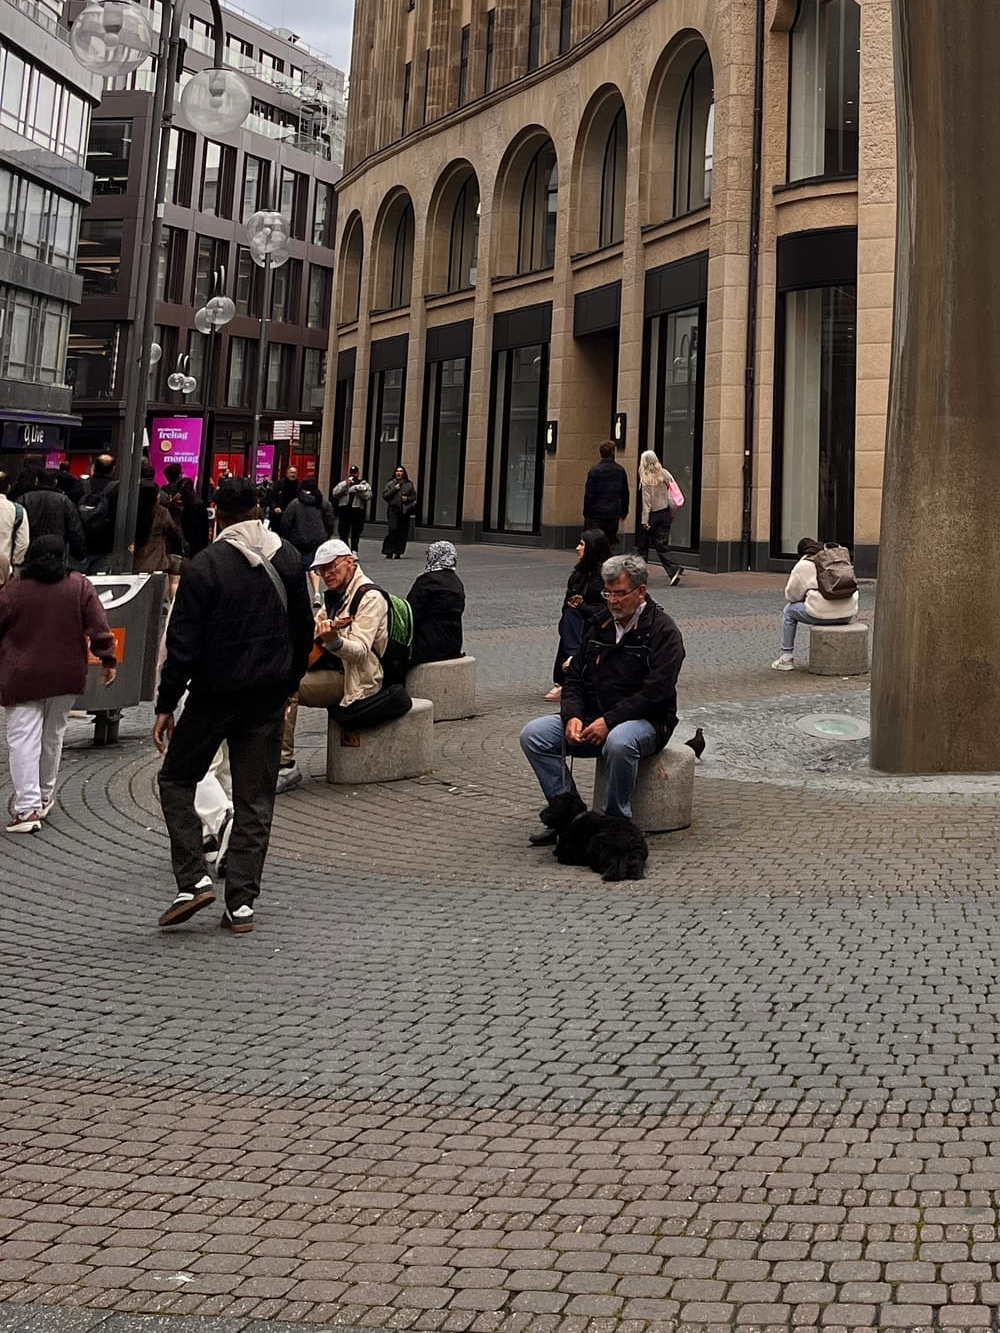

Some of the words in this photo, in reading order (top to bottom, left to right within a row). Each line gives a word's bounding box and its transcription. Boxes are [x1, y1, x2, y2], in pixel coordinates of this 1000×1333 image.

[31, 425, 44, 443] Live
[159, 430, 188, 440] freitag
[163, 454, 199, 464] montag
